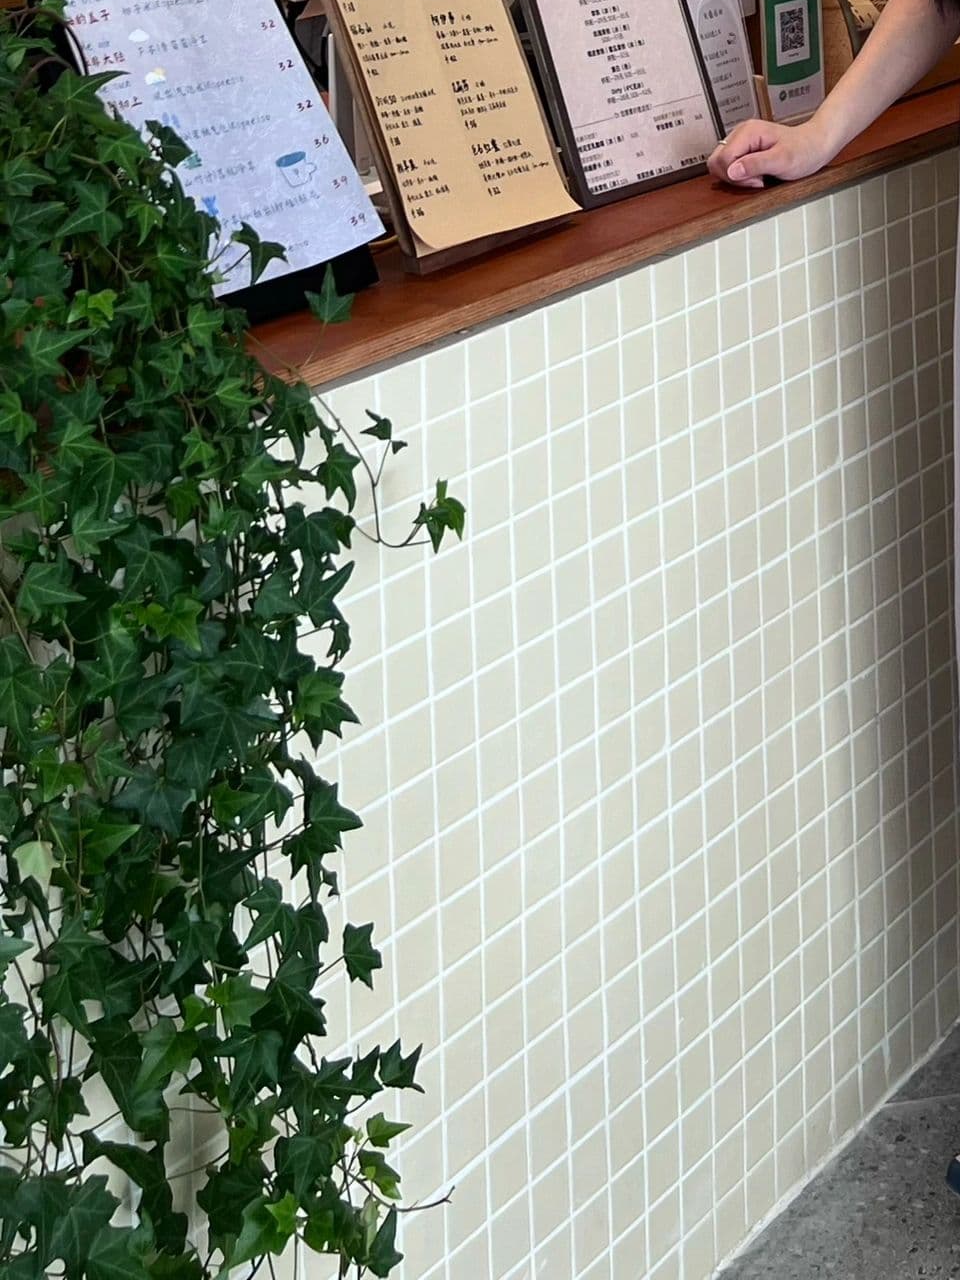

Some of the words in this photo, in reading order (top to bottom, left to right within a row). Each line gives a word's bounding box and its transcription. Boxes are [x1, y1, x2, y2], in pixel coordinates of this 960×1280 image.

[261, 19, 276, 31] 32
[278, 59, 294, 71] 32
[296, 98, 313, 114] 32
[313, 135, 329, 149] 36
[332, 175, 348, 189] 39
[350, 214, 366, 227] 39
